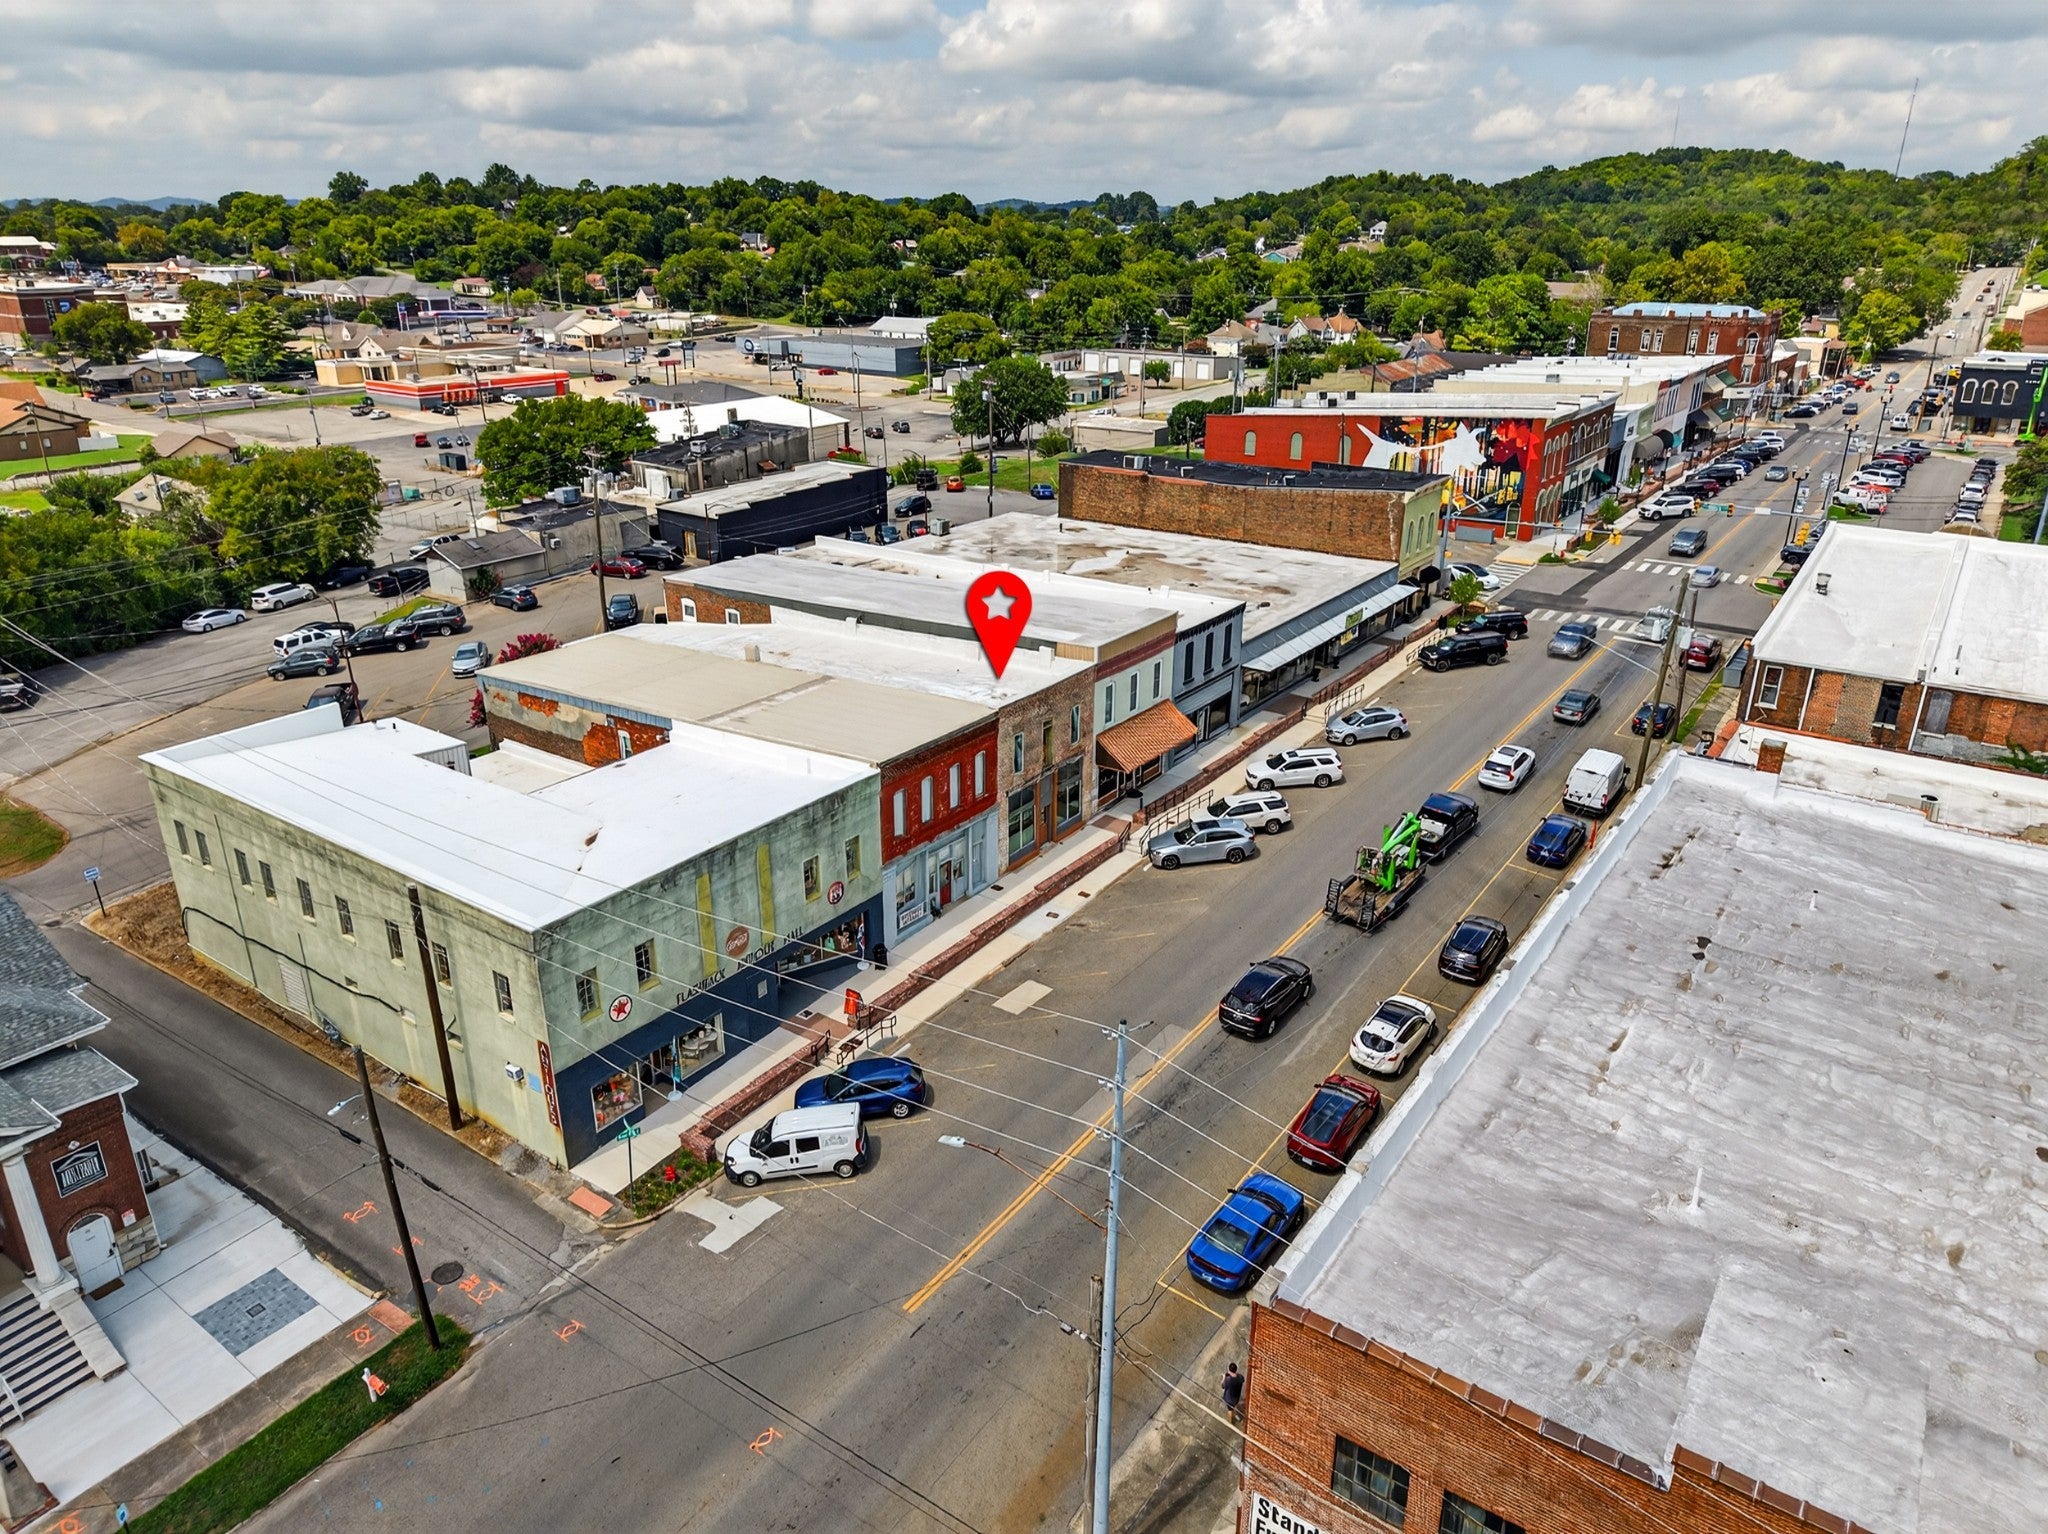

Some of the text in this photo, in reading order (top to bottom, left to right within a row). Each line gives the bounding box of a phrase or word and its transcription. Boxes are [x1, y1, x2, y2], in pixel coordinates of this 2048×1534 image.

[676, 968, 725, 1005] FLASHBACK
[737, 940, 775, 971] ANTIQUE
[1258, 1497, 1319, 1534] Stan
